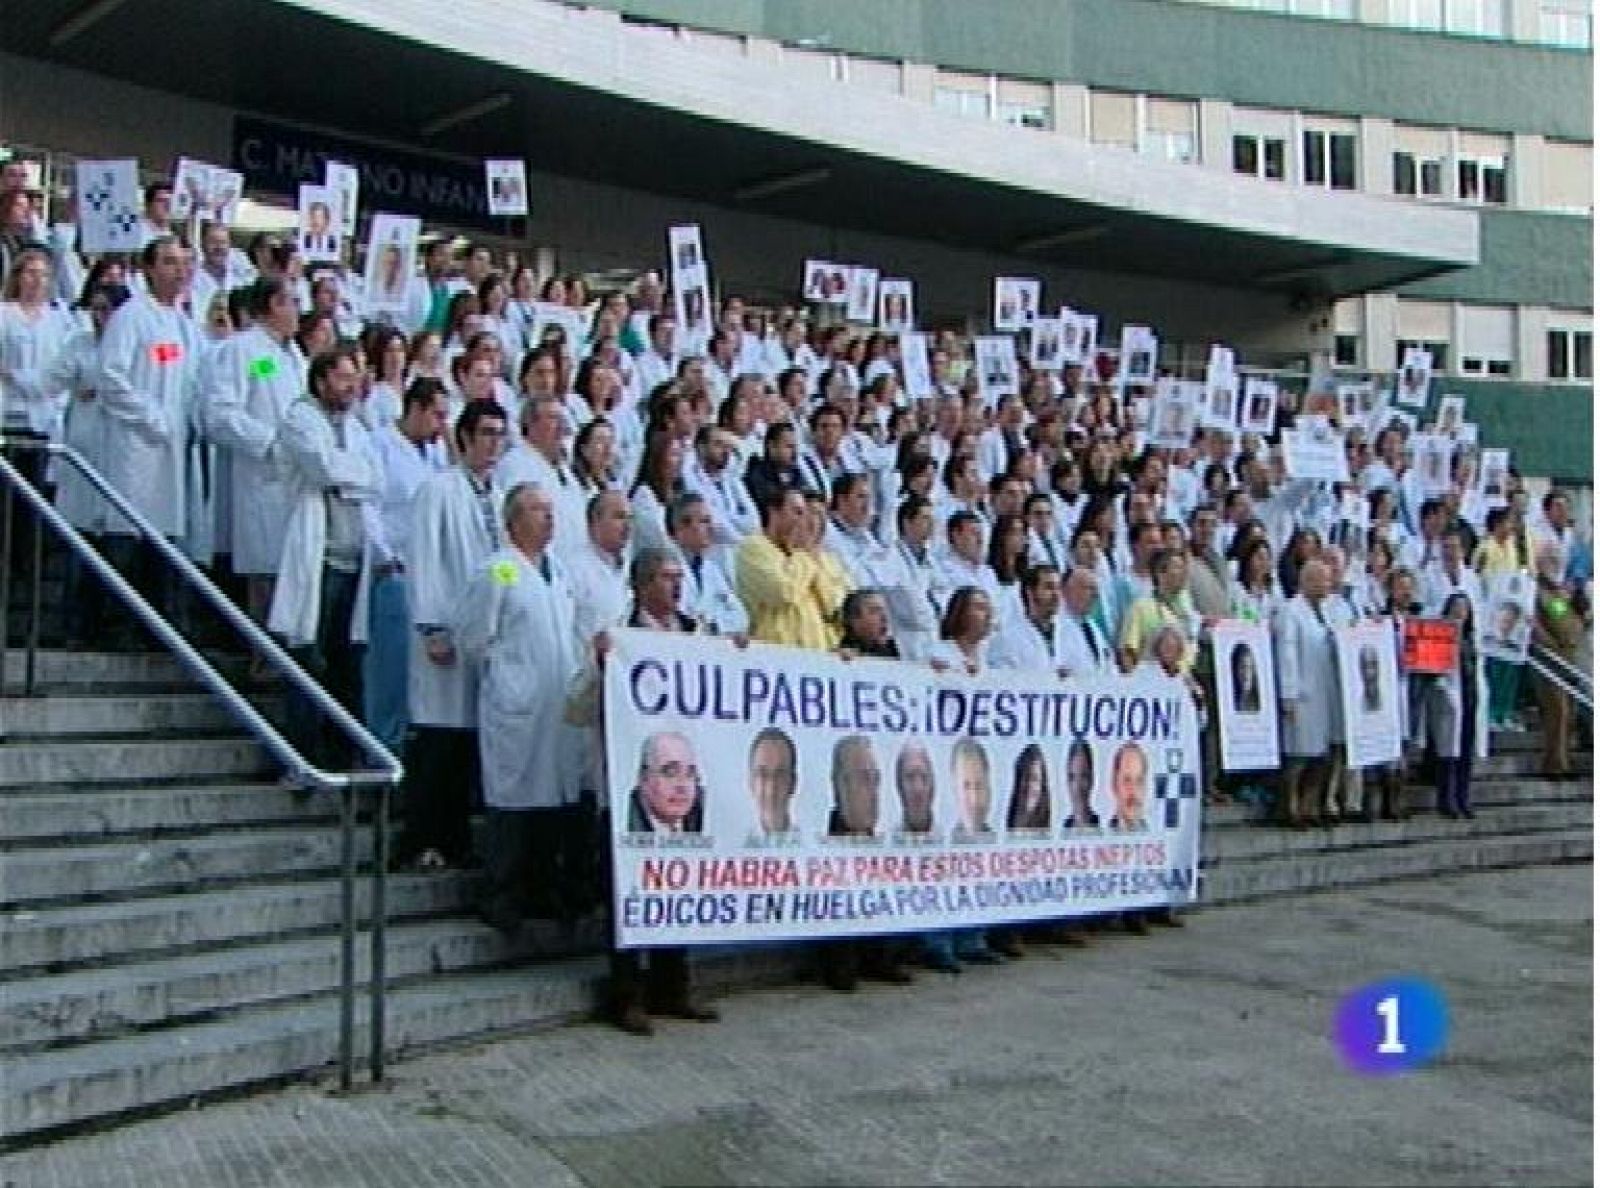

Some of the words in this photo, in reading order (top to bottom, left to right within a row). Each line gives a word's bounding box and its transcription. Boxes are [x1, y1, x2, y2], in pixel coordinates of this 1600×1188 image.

[629, 659, 919, 732] CULPABLES:
[642, 859, 690, 890] NO
[697, 856, 801, 891] HABRA
[853, 855, 916, 884] PARA
[918, 851, 985, 882] ESTOS
[990, 847, 1089, 878] DESPOTAS
[745, 893, 786, 924] EN
[791, 888, 896, 924] HUELGA
